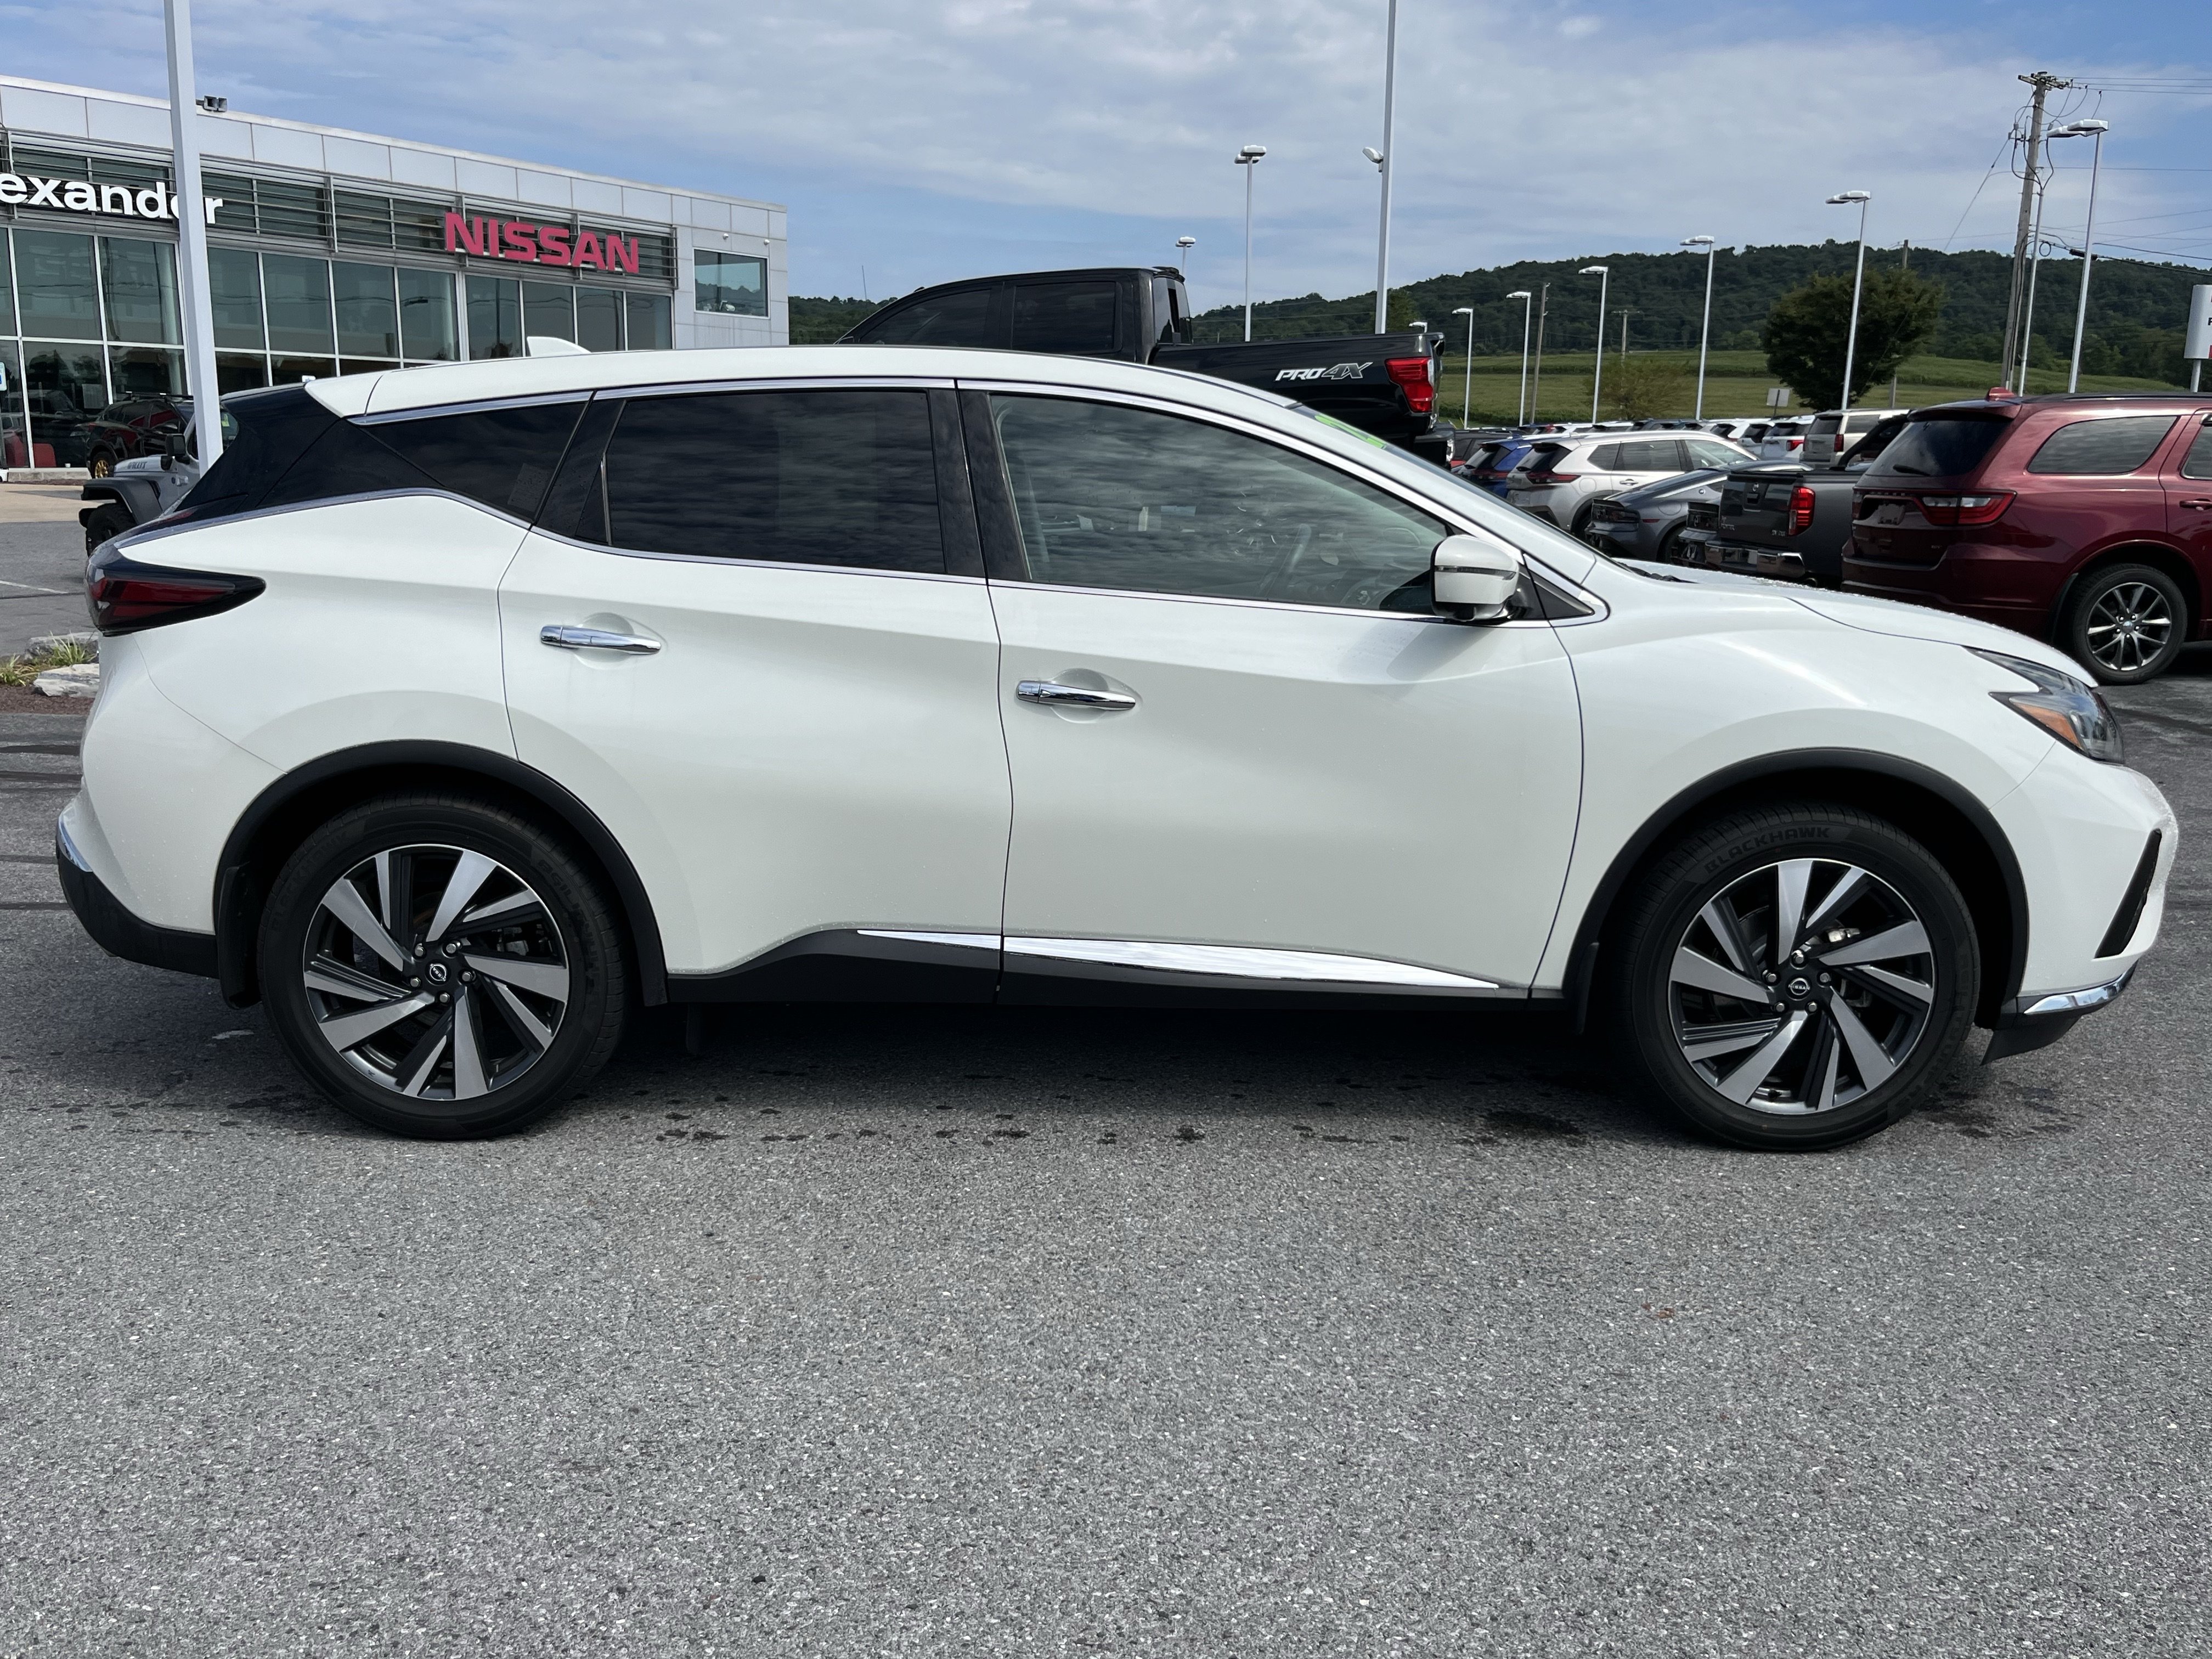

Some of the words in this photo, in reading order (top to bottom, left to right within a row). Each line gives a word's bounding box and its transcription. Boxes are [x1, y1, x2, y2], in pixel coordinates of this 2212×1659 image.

[0, 173, 223, 224] exandr
[445, 212, 639, 274] NISSAN
[1703, 827, 1830, 874] BLACKHAWK
